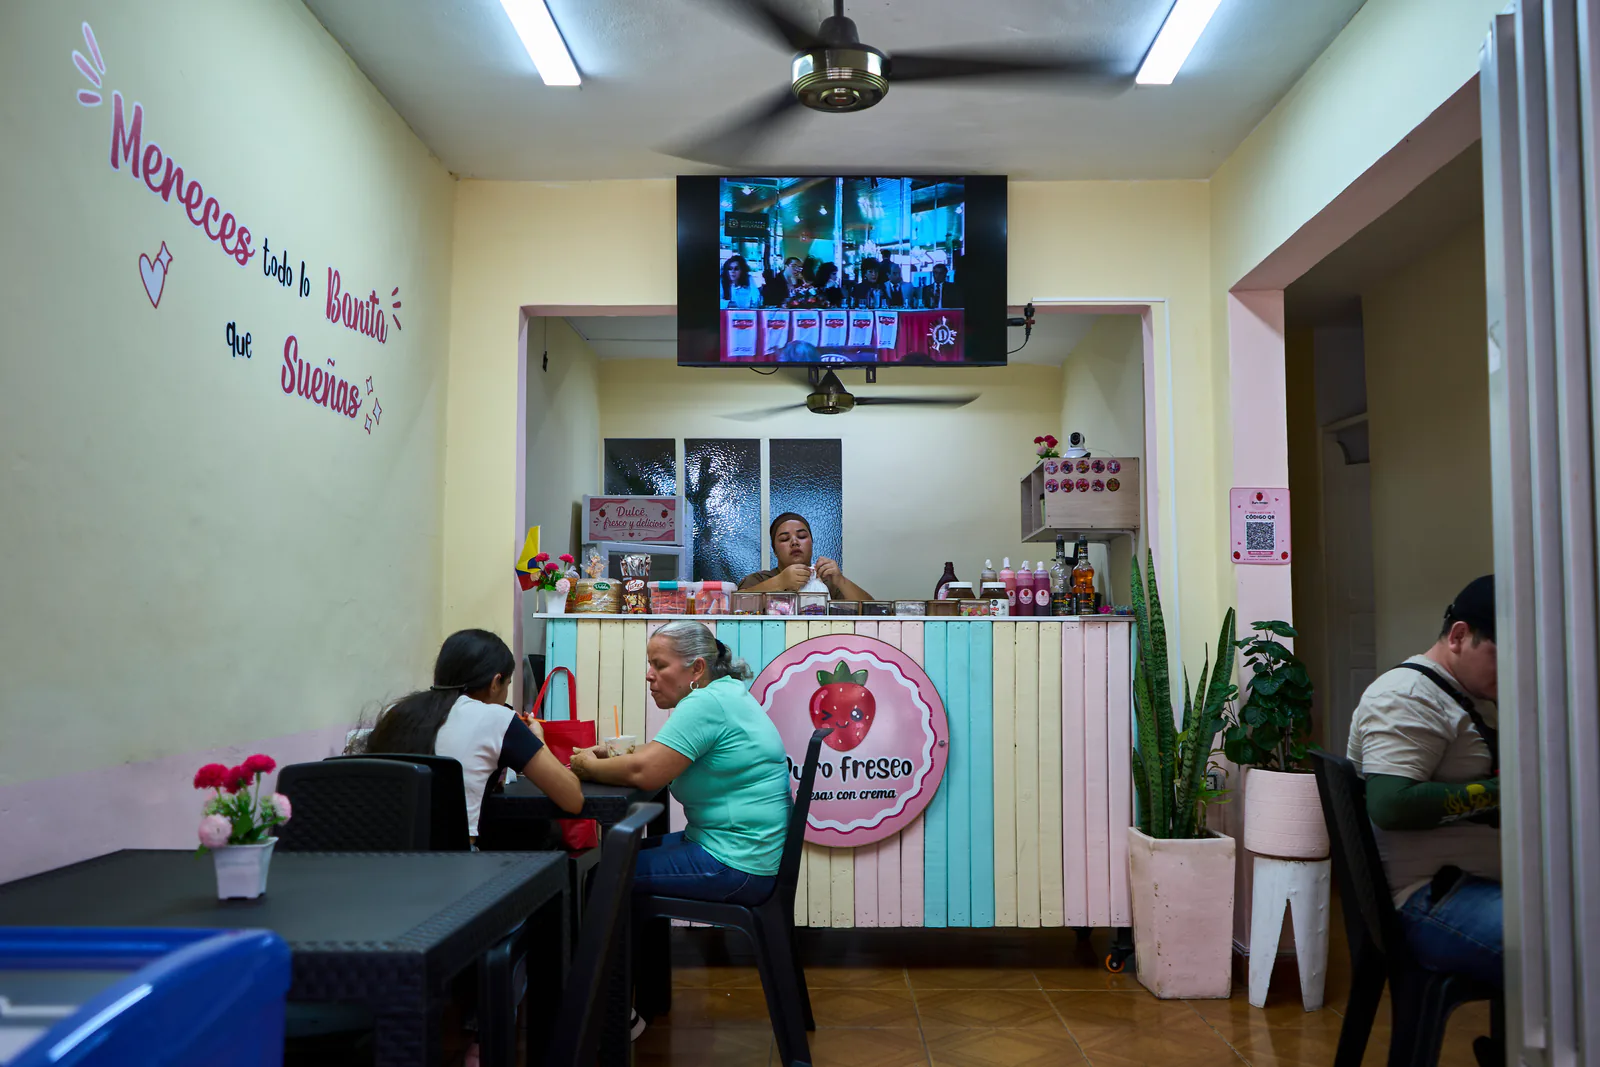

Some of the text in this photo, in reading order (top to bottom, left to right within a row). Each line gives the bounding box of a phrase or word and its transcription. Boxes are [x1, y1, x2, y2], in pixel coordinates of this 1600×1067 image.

[262, 237, 293, 287] todo
[299, 260, 311, 298] lo
[226, 321, 363, 419] que Sueñas
[603, 516, 666, 531] fresco y delicioso
[836, 790, 857, 800] con
[859, 788, 897, 800] crema
